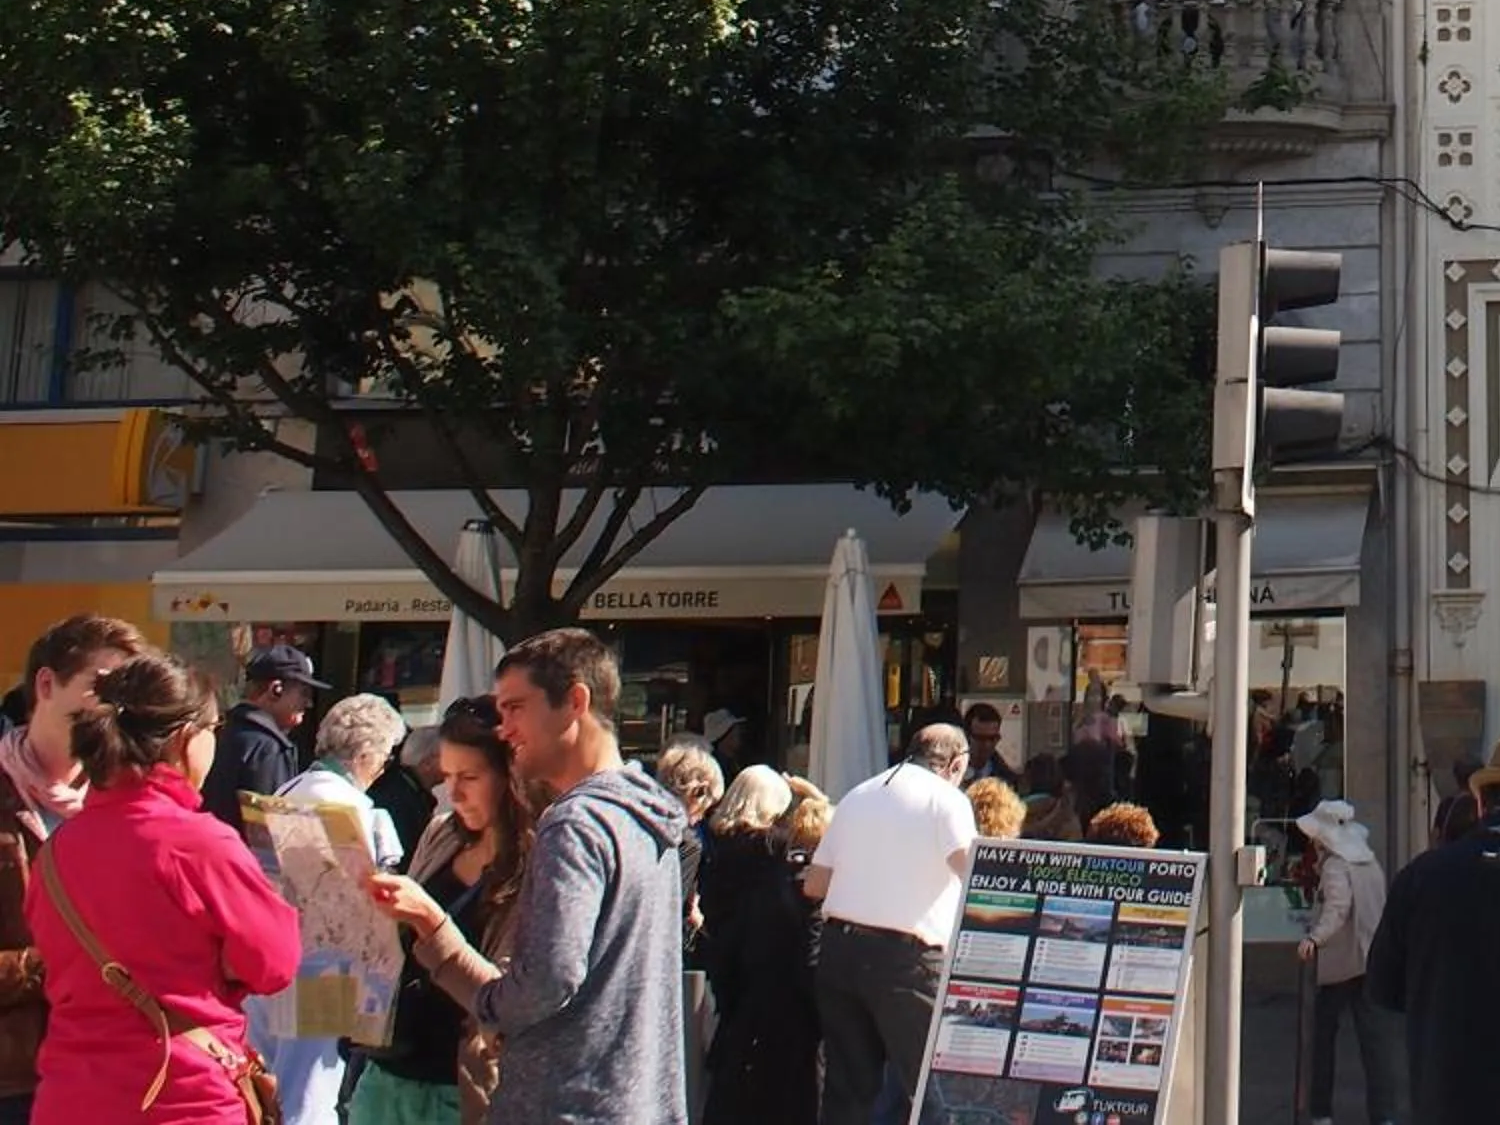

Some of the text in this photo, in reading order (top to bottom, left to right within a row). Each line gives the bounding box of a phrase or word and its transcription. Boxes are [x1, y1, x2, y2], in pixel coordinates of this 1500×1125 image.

[345, 598, 450, 613] Padaria Resta
[595, 590, 719, 609] BELLA TORRE
[978, 846, 1196, 878] HAVE FUN WITH TUKTOUR PORTO
[971, 875, 1194, 906] ENJOY A RIDE WITH TOUR GUIDE
[1093, 1099, 1149, 1115] TUKTOUR
